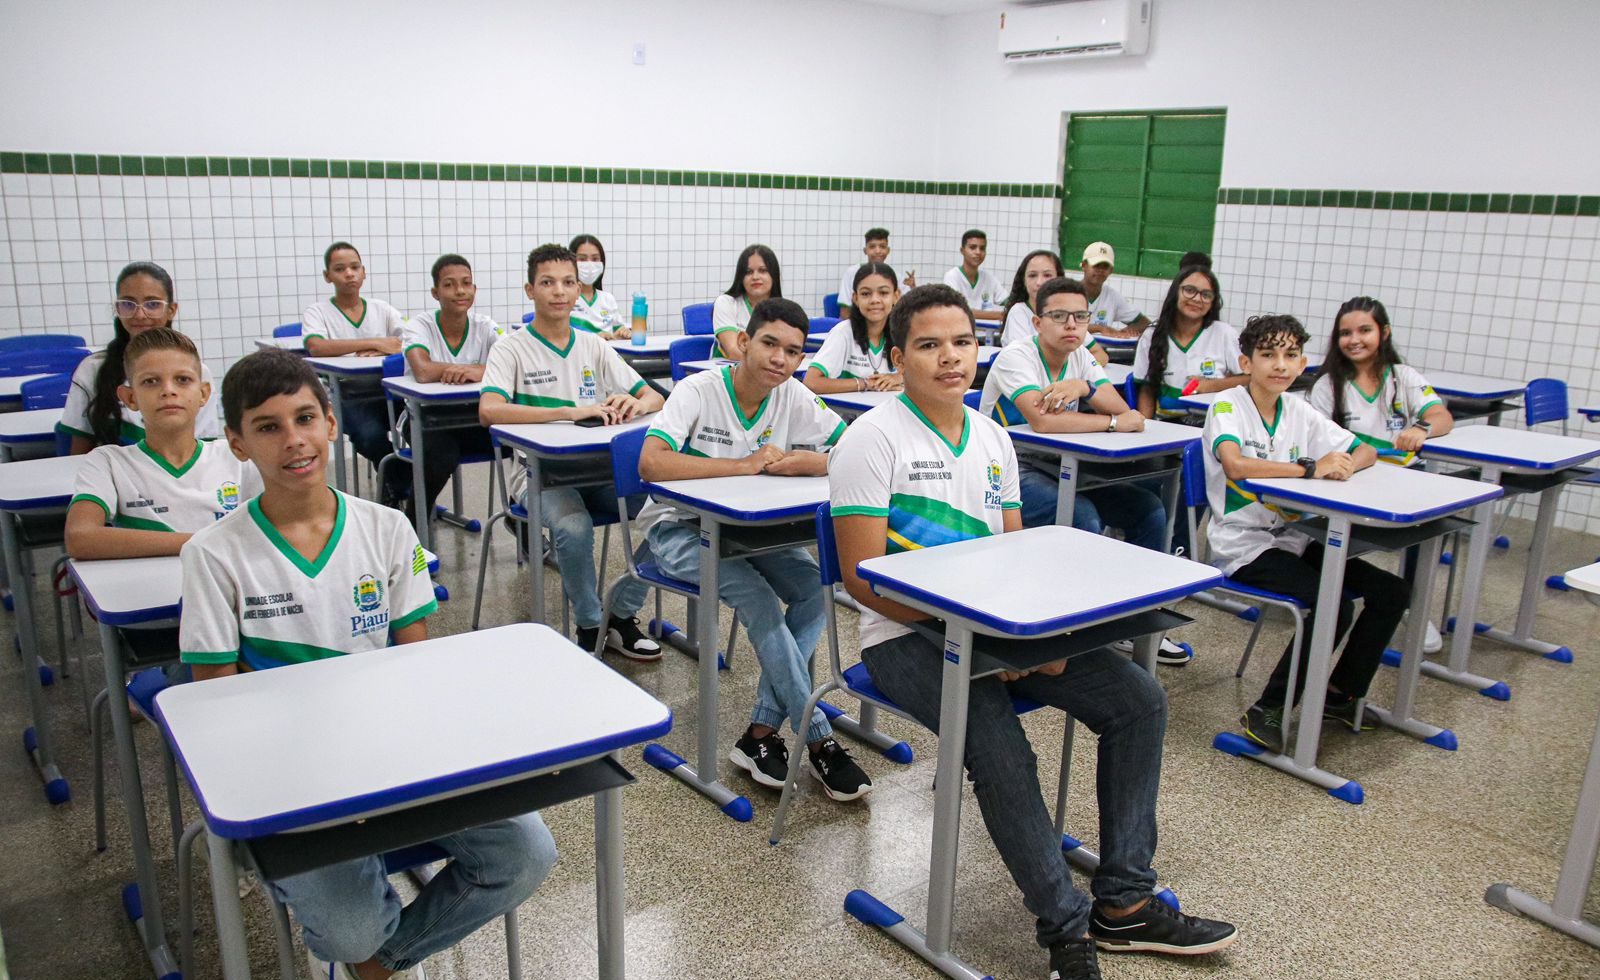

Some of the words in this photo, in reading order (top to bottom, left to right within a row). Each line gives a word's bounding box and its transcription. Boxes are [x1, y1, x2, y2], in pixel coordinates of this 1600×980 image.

[984, 490, 1001, 504] Pia
[269, 592, 294, 604] ESCOLAR
[350, 608, 389, 632] Piauí
